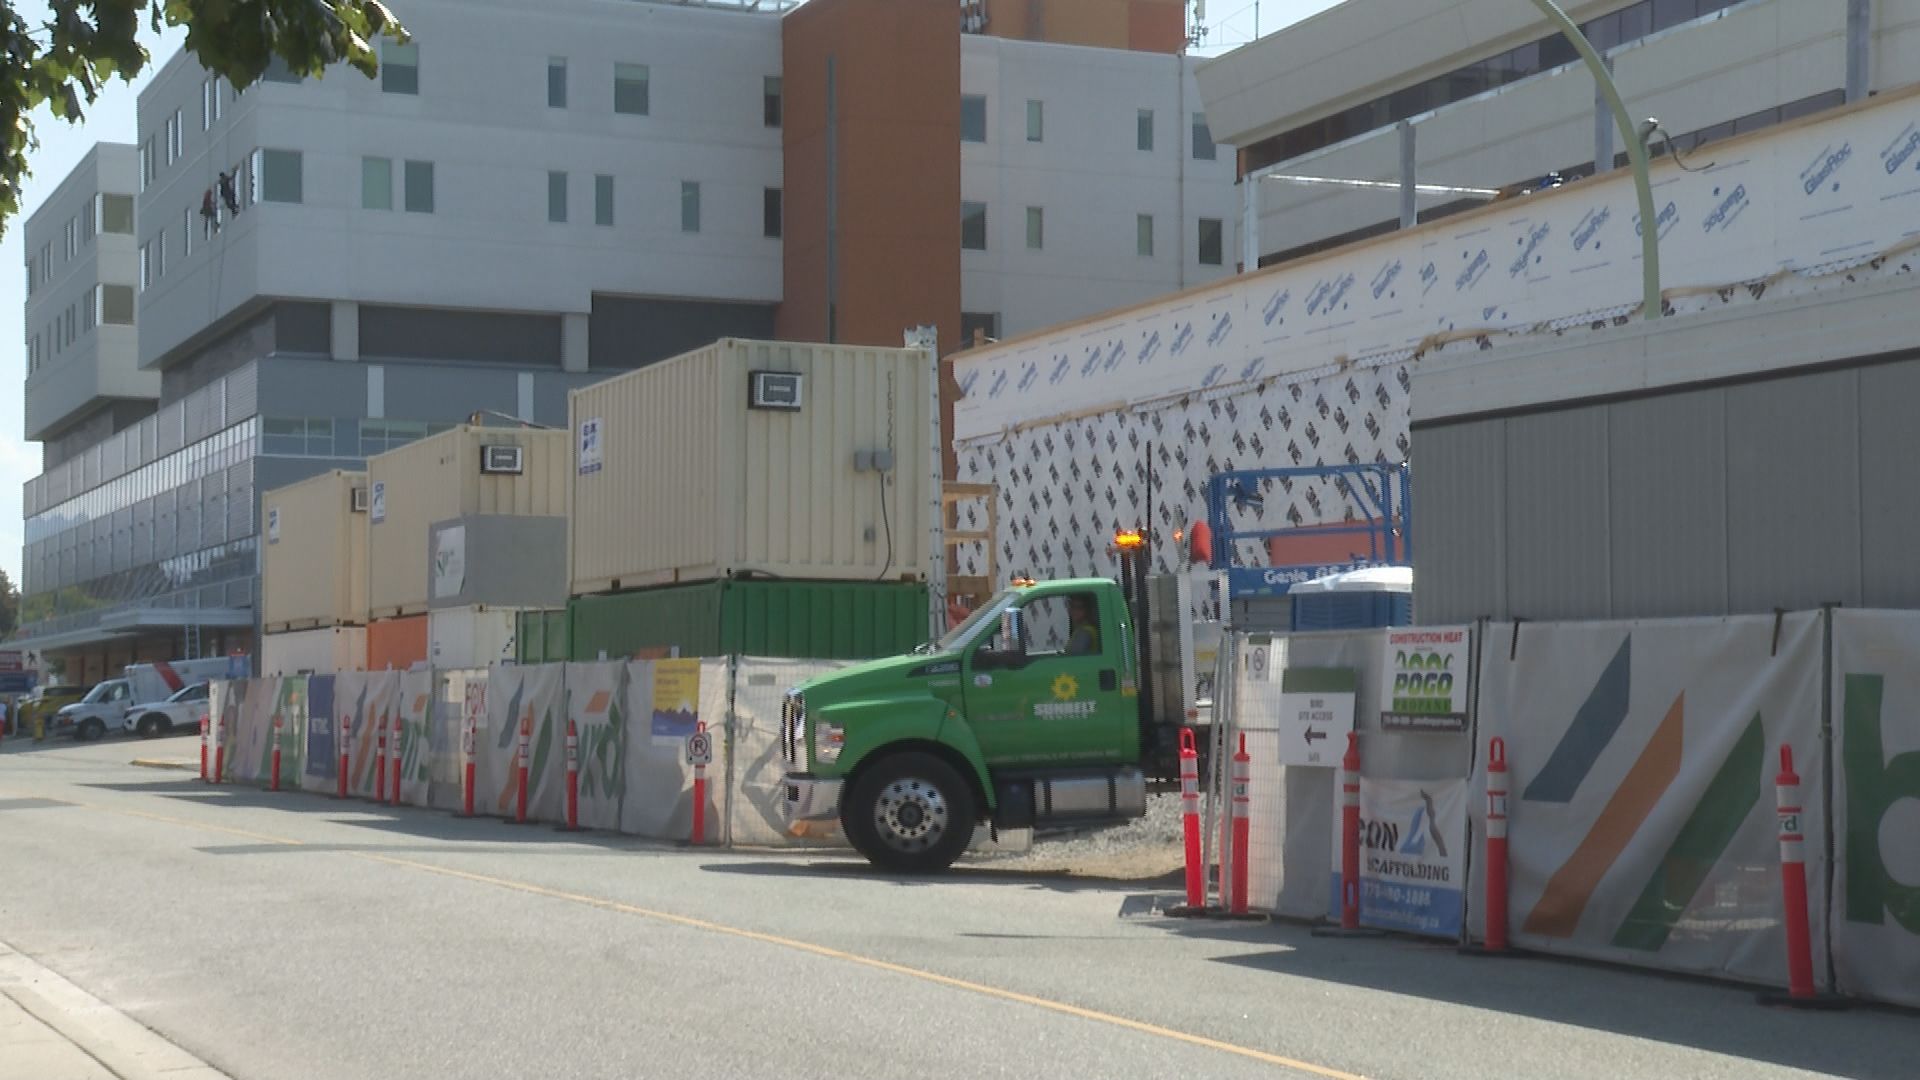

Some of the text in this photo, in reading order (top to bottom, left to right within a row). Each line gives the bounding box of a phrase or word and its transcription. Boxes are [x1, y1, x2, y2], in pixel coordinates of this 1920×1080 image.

[1804, 142, 1852, 195] GlasRoc
[1264, 568, 1309, 585] Genie
[1390, 631, 1463, 644] CONSTRUCTION HEAT
[1393, 672, 1453, 696] POGO
[1034, 701, 1096, 716] SUNBELT
[1366, 857, 1450, 882] SCAFFOLDING
